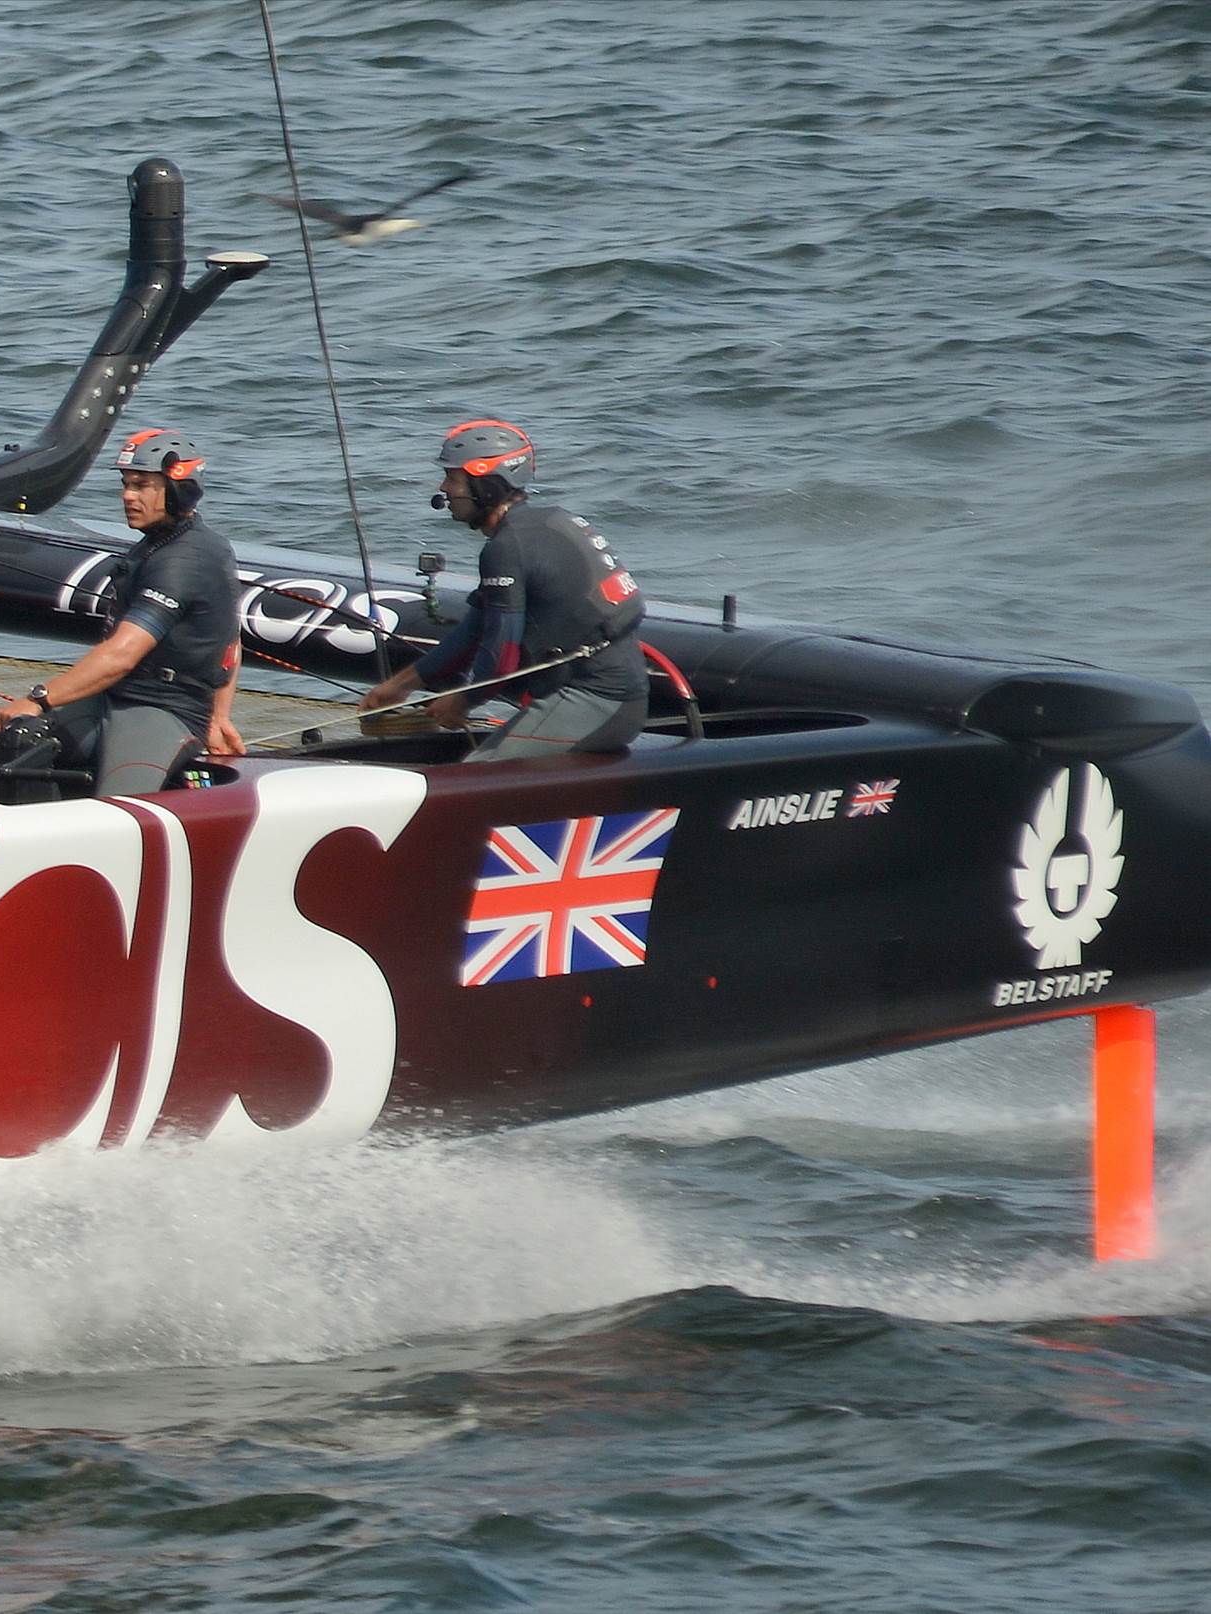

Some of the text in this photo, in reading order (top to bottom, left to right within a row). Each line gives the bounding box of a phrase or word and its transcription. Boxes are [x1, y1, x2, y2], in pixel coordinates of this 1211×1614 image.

[53, 550, 427, 653] IOS
[728, 789, 843, 831] AINSLIE
[993, 970, 1113, 1007] BELSTAFF
